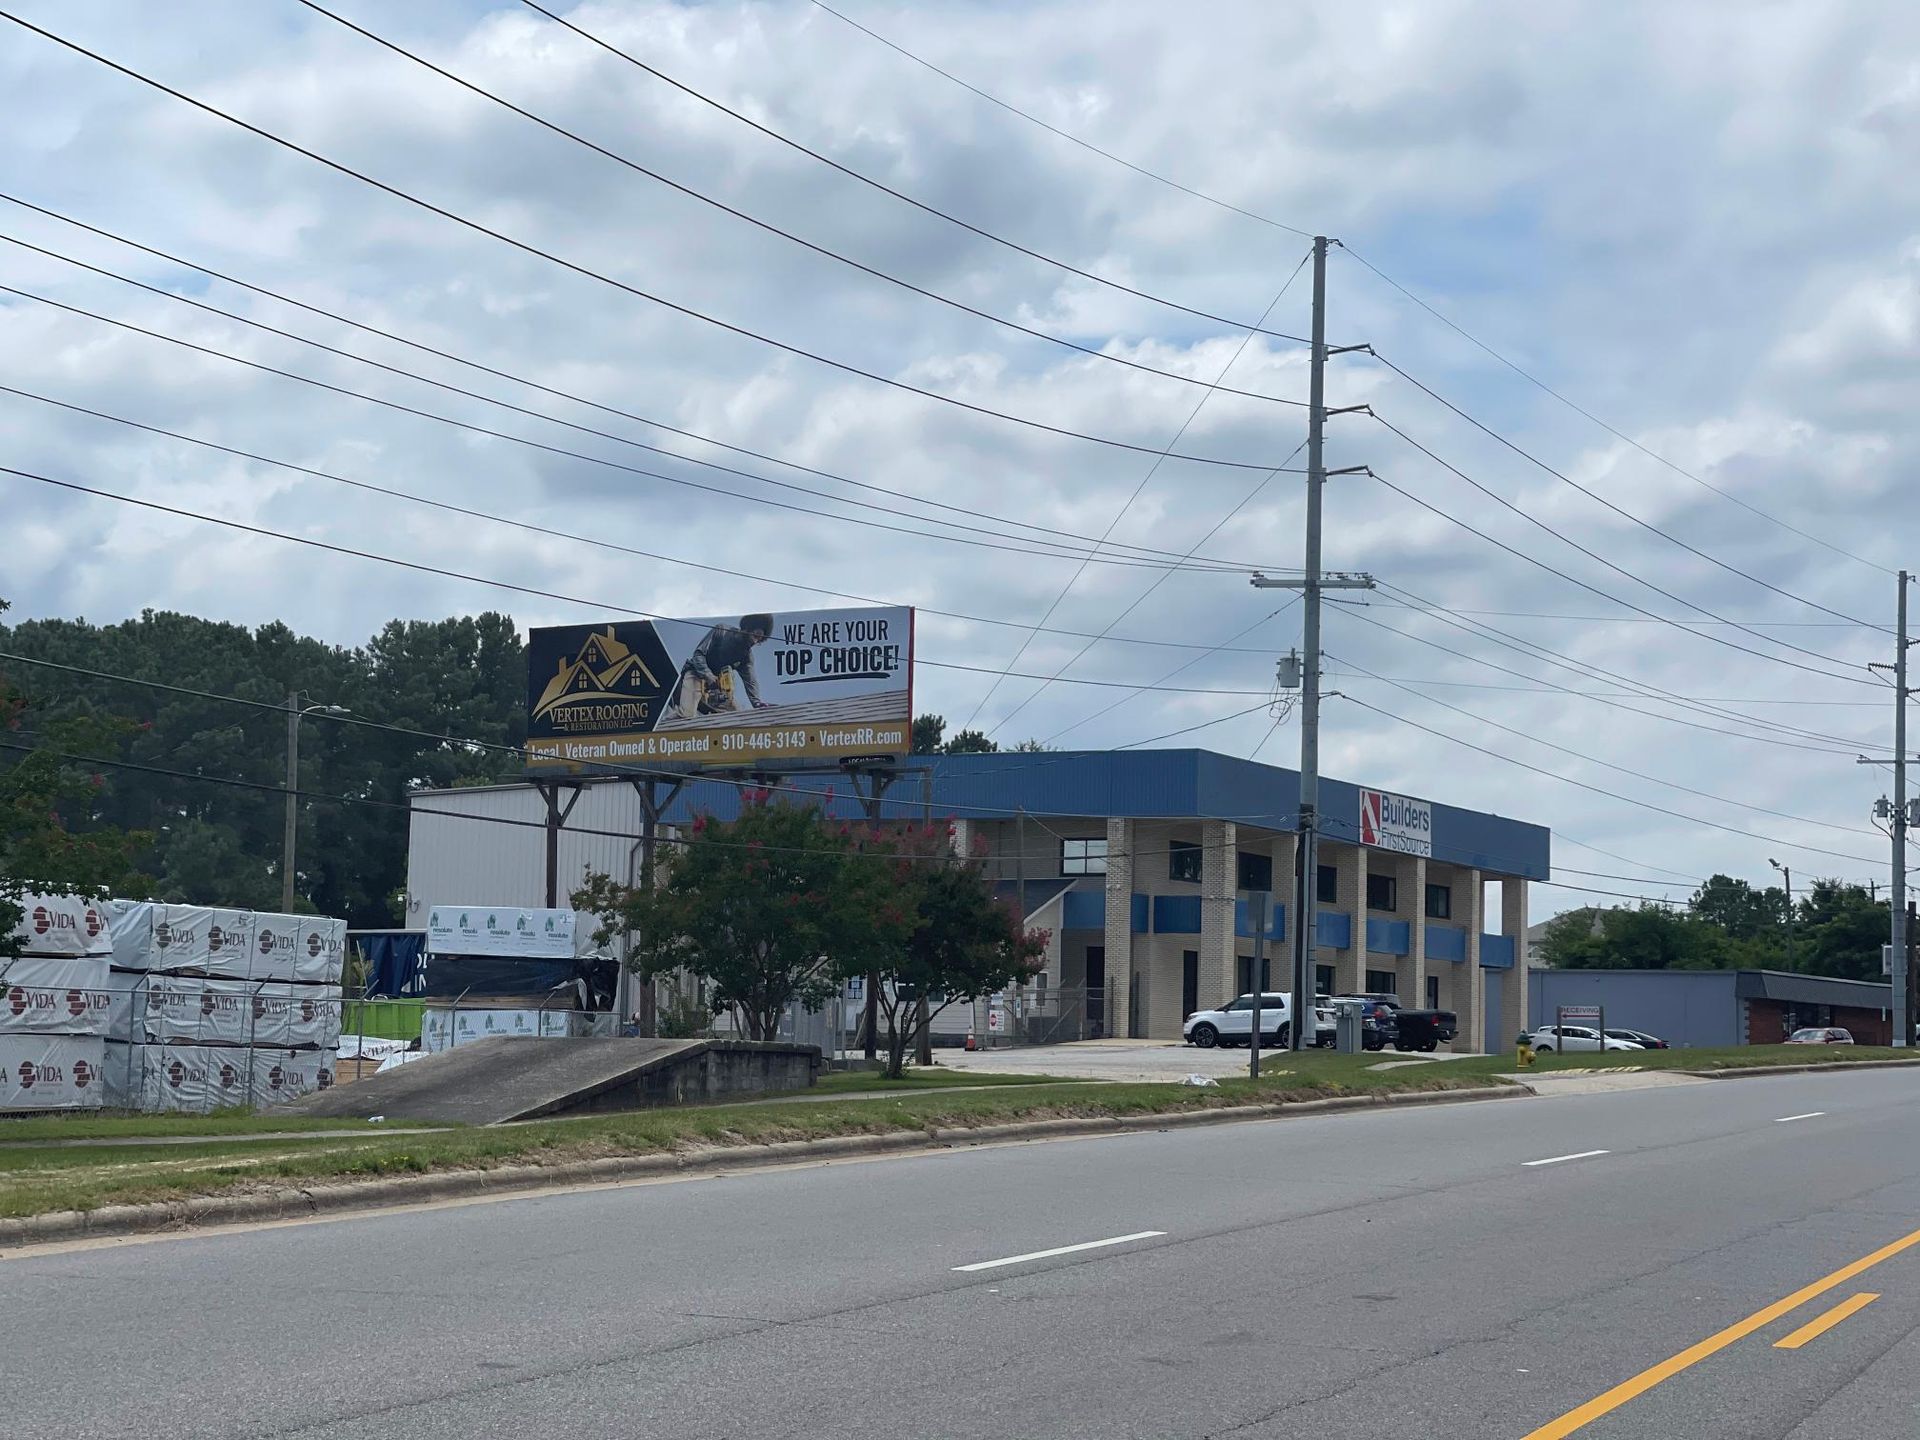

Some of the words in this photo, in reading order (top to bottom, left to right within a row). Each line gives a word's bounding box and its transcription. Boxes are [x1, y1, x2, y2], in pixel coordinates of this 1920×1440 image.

[784, 624, 806, 646] WE
[811, 622, 840, 644] ARE
[846, 620, 888, 642] YOUR
[774, 649, 813, 676] TOP
[820, 645, 900, 674] CHOICE!
[549, 706, 595, 723] VERTEX
[596, 702, 649, 721] ROOFING
[571, 720, 619, 732] RESTORATION
[620, 719, 634, 729] LLC
[565, 743, 606, 758] Veteran
[610, 739, 645, 757] Owned
[648, 737, 656, 754] &
[660, 735, 709, 756] Operated
[722, 730, 806, 750] 910-446-3143
[820, 728, 902, 747] VertexRR.com
[1381, 795, 1430, 832] Builders
[1381, 827, 1430, 856] FirstSource
[49, 911, 76, 929] VIDA
[272, 934, 296, 950] VIDA
[26, 992, 56, 1009] VIDA
[35, 1064, 63, 1082] VIDA
[283, 1071, 304, 1086] VIDA
